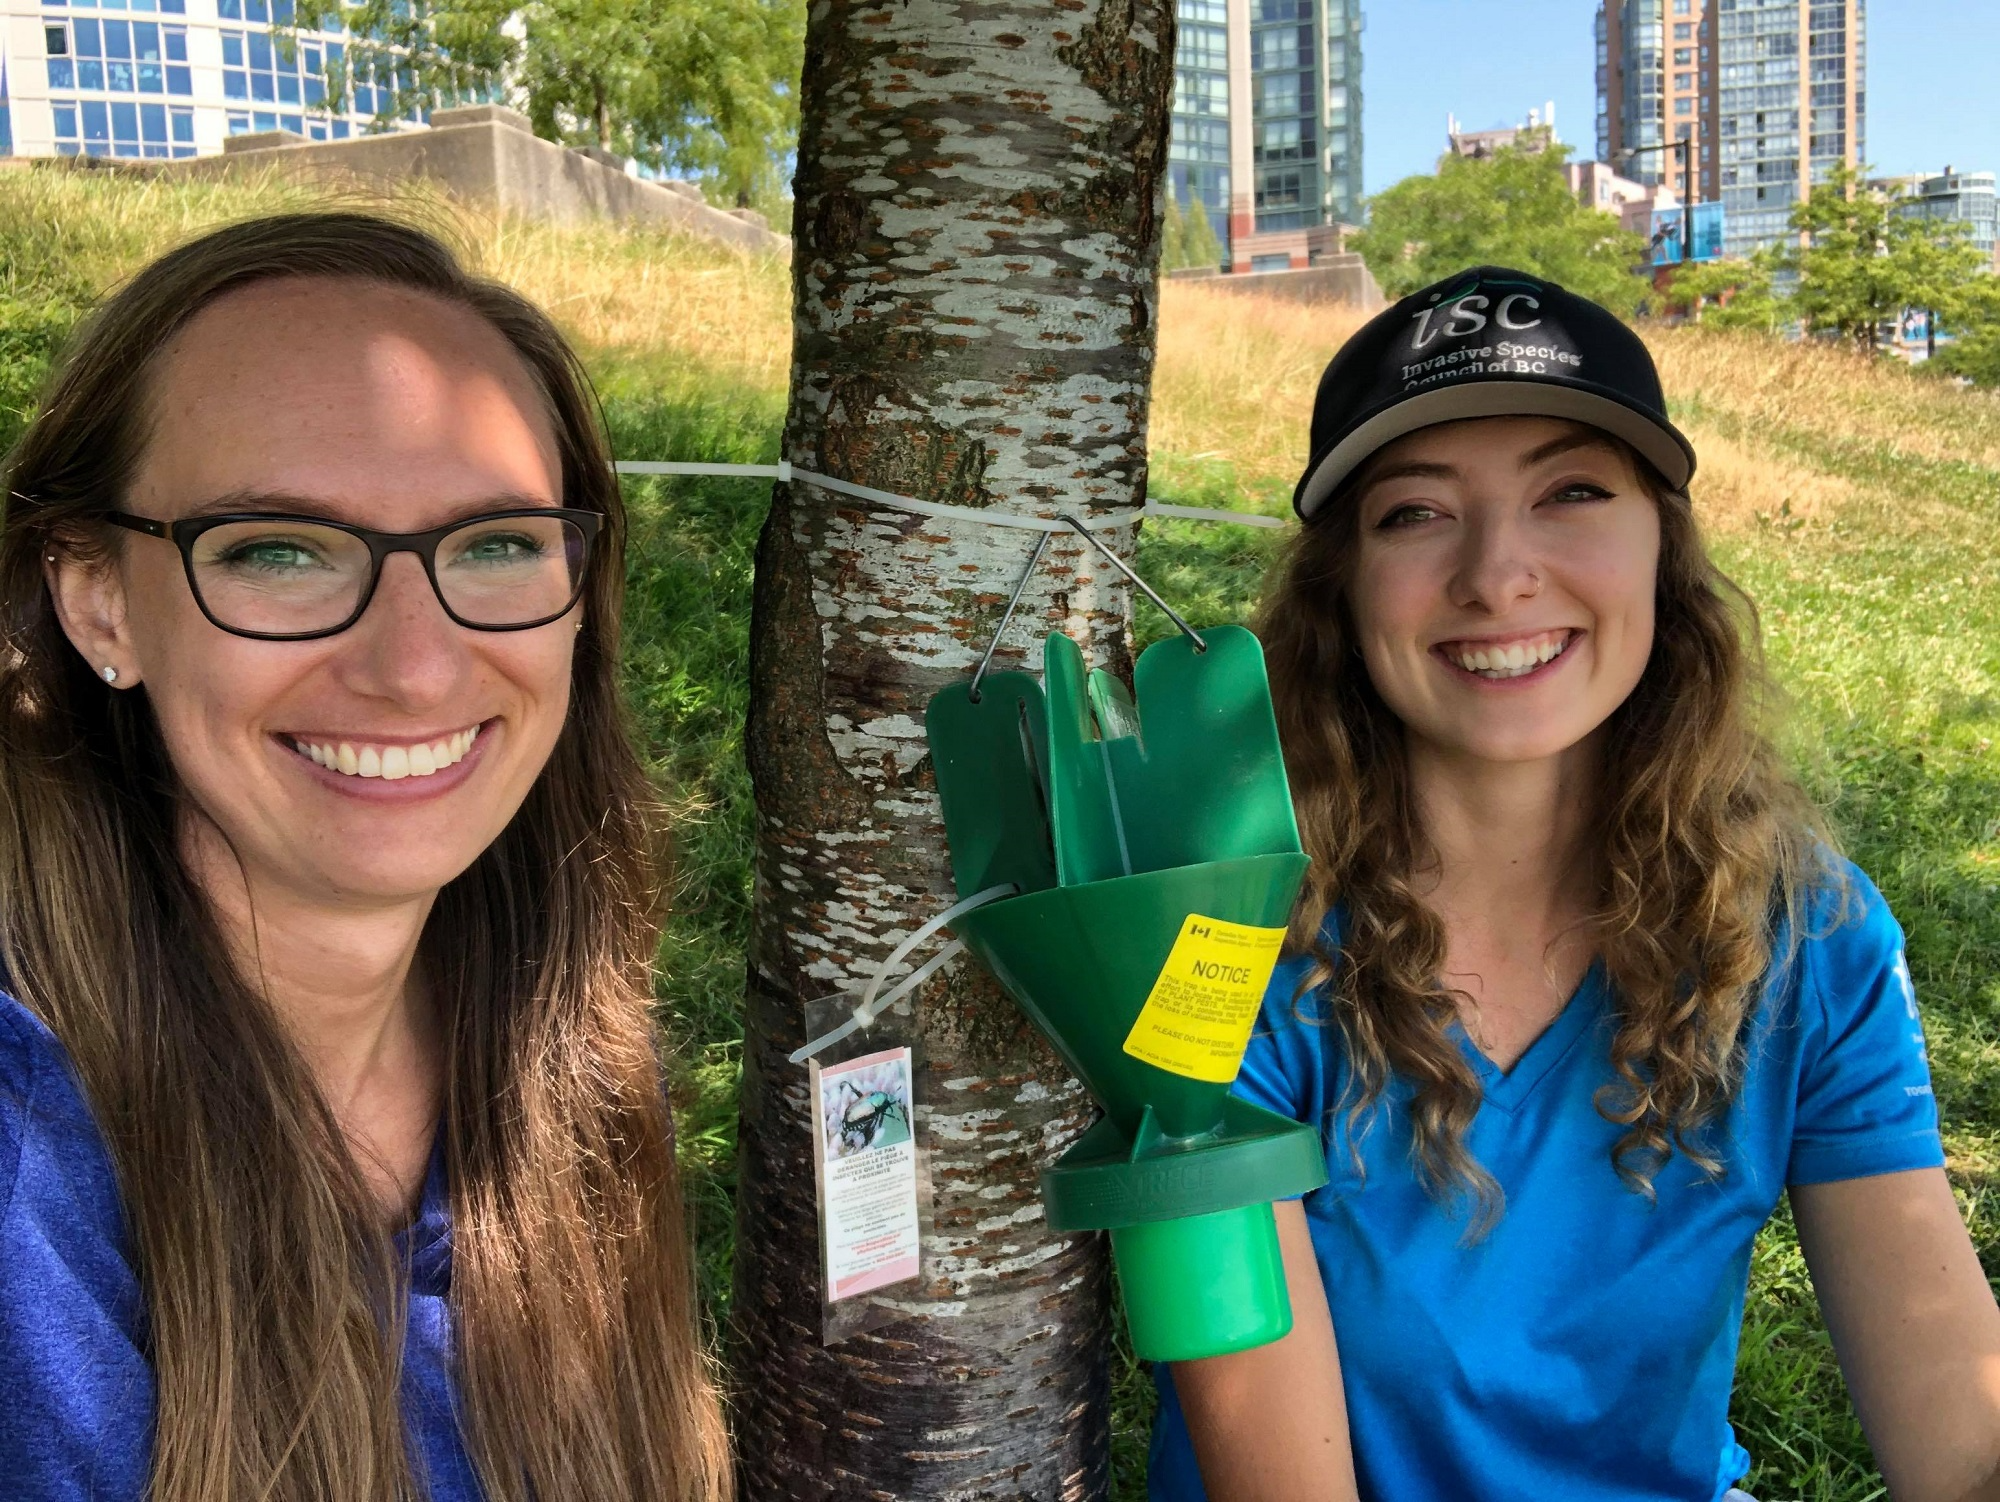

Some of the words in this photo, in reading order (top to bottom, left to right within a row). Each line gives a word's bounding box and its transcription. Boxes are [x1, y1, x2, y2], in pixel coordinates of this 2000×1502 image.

[1402, 345, 1492, 380] Invasive
[1496, 340, 1582, 366] Species
[1488, 359, 1511, 373] of
[1514, 359, 1546, 374] BC
[1192, 960, 1252, 985] NOTICE
[1160, 982, 1181, 992] effort
[1164, 974, 1179, 985] This
[1183, 980, 1198, 990] trap
[1154, 994, 1169, 1004] trap
[1168, 990, 1194, 1002] PLANT
[1152, 1024, 1184, 1040] PLEASE
[1183, 1034, 1195, 1043] DO
[1195, 1038, 1211, 1046] NOT
[885, 1156, 908, 1165] TROUVE
